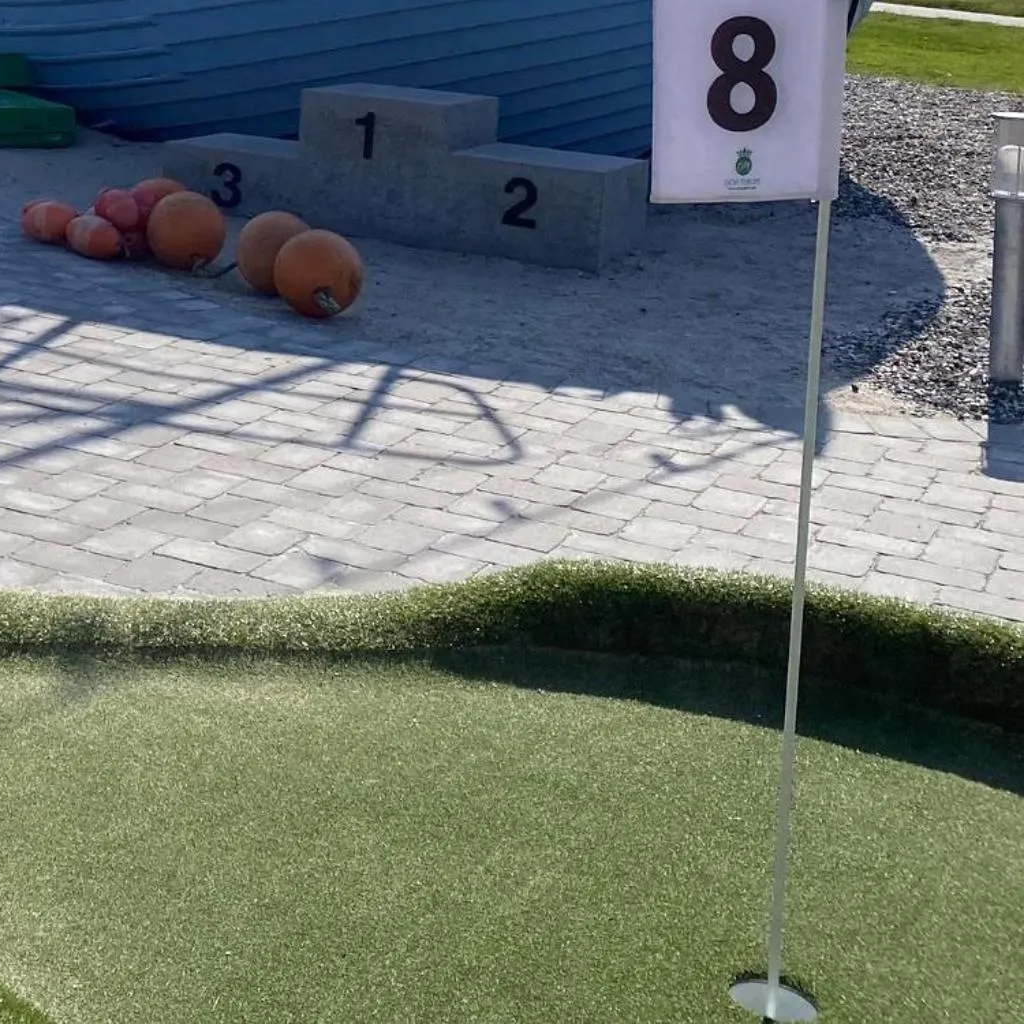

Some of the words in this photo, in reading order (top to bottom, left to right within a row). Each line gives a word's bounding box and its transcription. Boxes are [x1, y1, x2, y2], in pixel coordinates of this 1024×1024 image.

[707, 16, 777, 132] 8
[355, 111, 375, 160] 1
[211, 162, 242, 208] 3
[502, 177, 538, 229] 2
